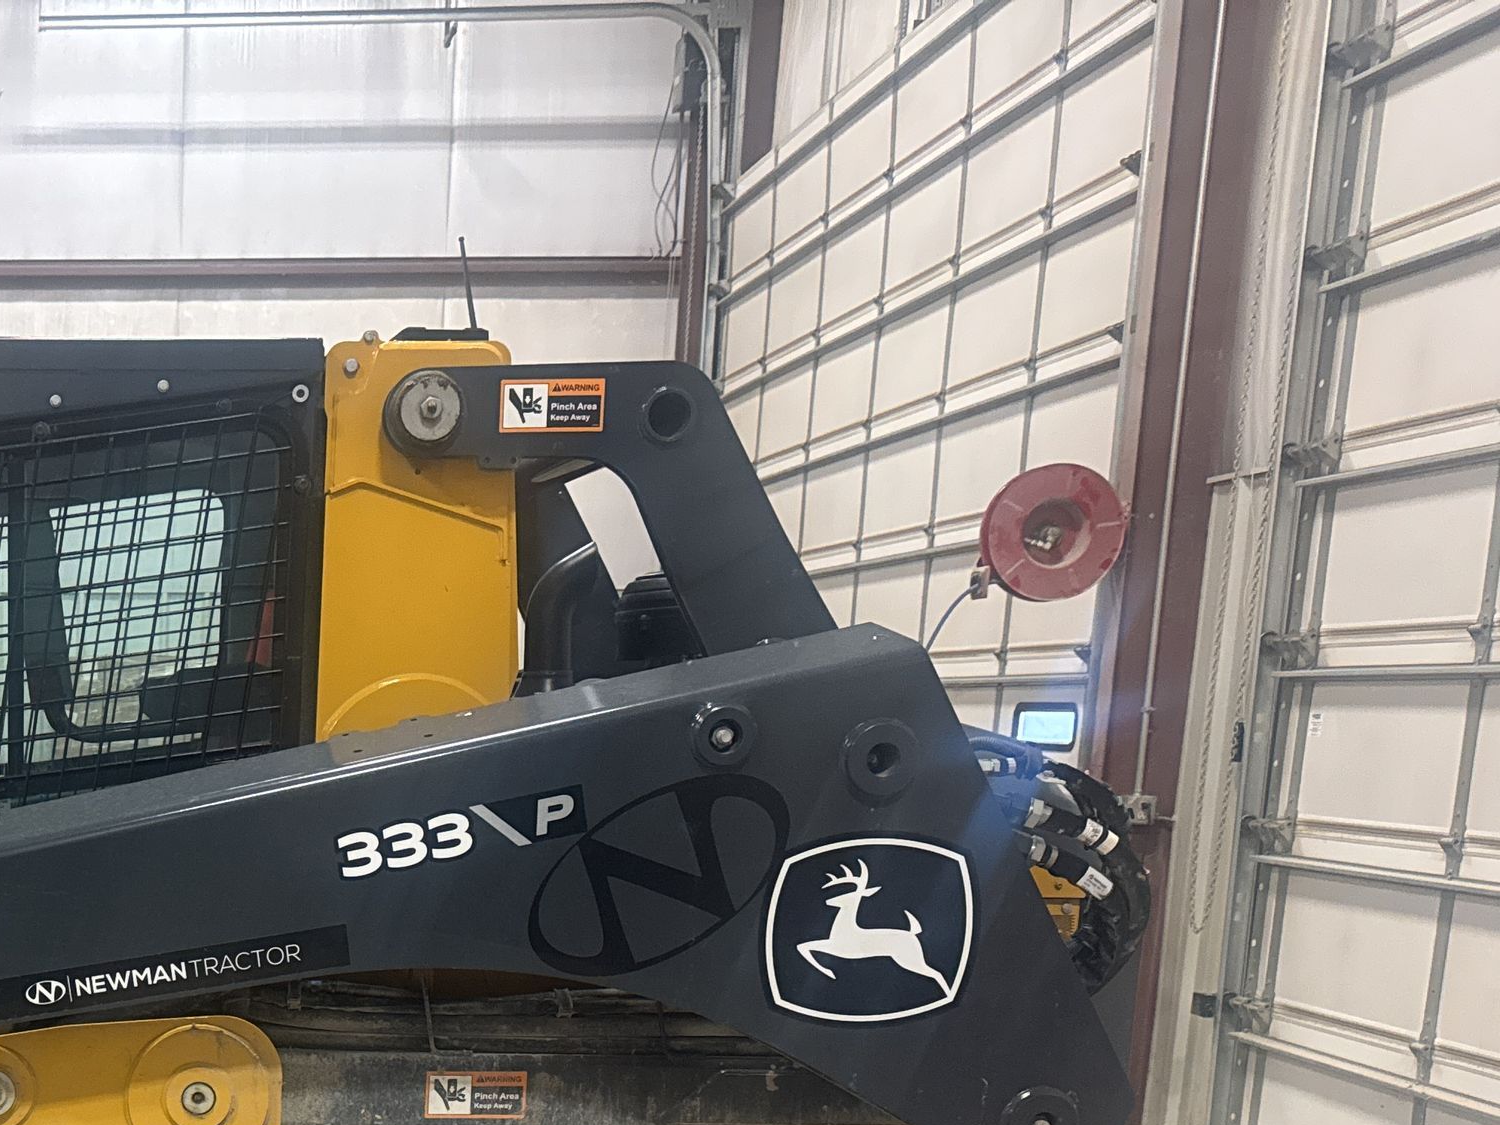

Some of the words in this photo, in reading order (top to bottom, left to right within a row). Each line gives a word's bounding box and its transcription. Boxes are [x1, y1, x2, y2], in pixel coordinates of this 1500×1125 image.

[561, 384, 600, 392] WARNING
[550, 402, 575, 411] Pinch
[577, 402, 598, 411] Area
[550, 414, 569, 422] Keep
[570, 414, 591, 422] Away
[484, 1075, 523, 1083] WARNING
[474, 1092, 498, 1100] Pinch
[499, 1092, 520, 1101] Area
[473, 1102, 492, 1110] Keep
[493, 1102, 513, 1110] Away
